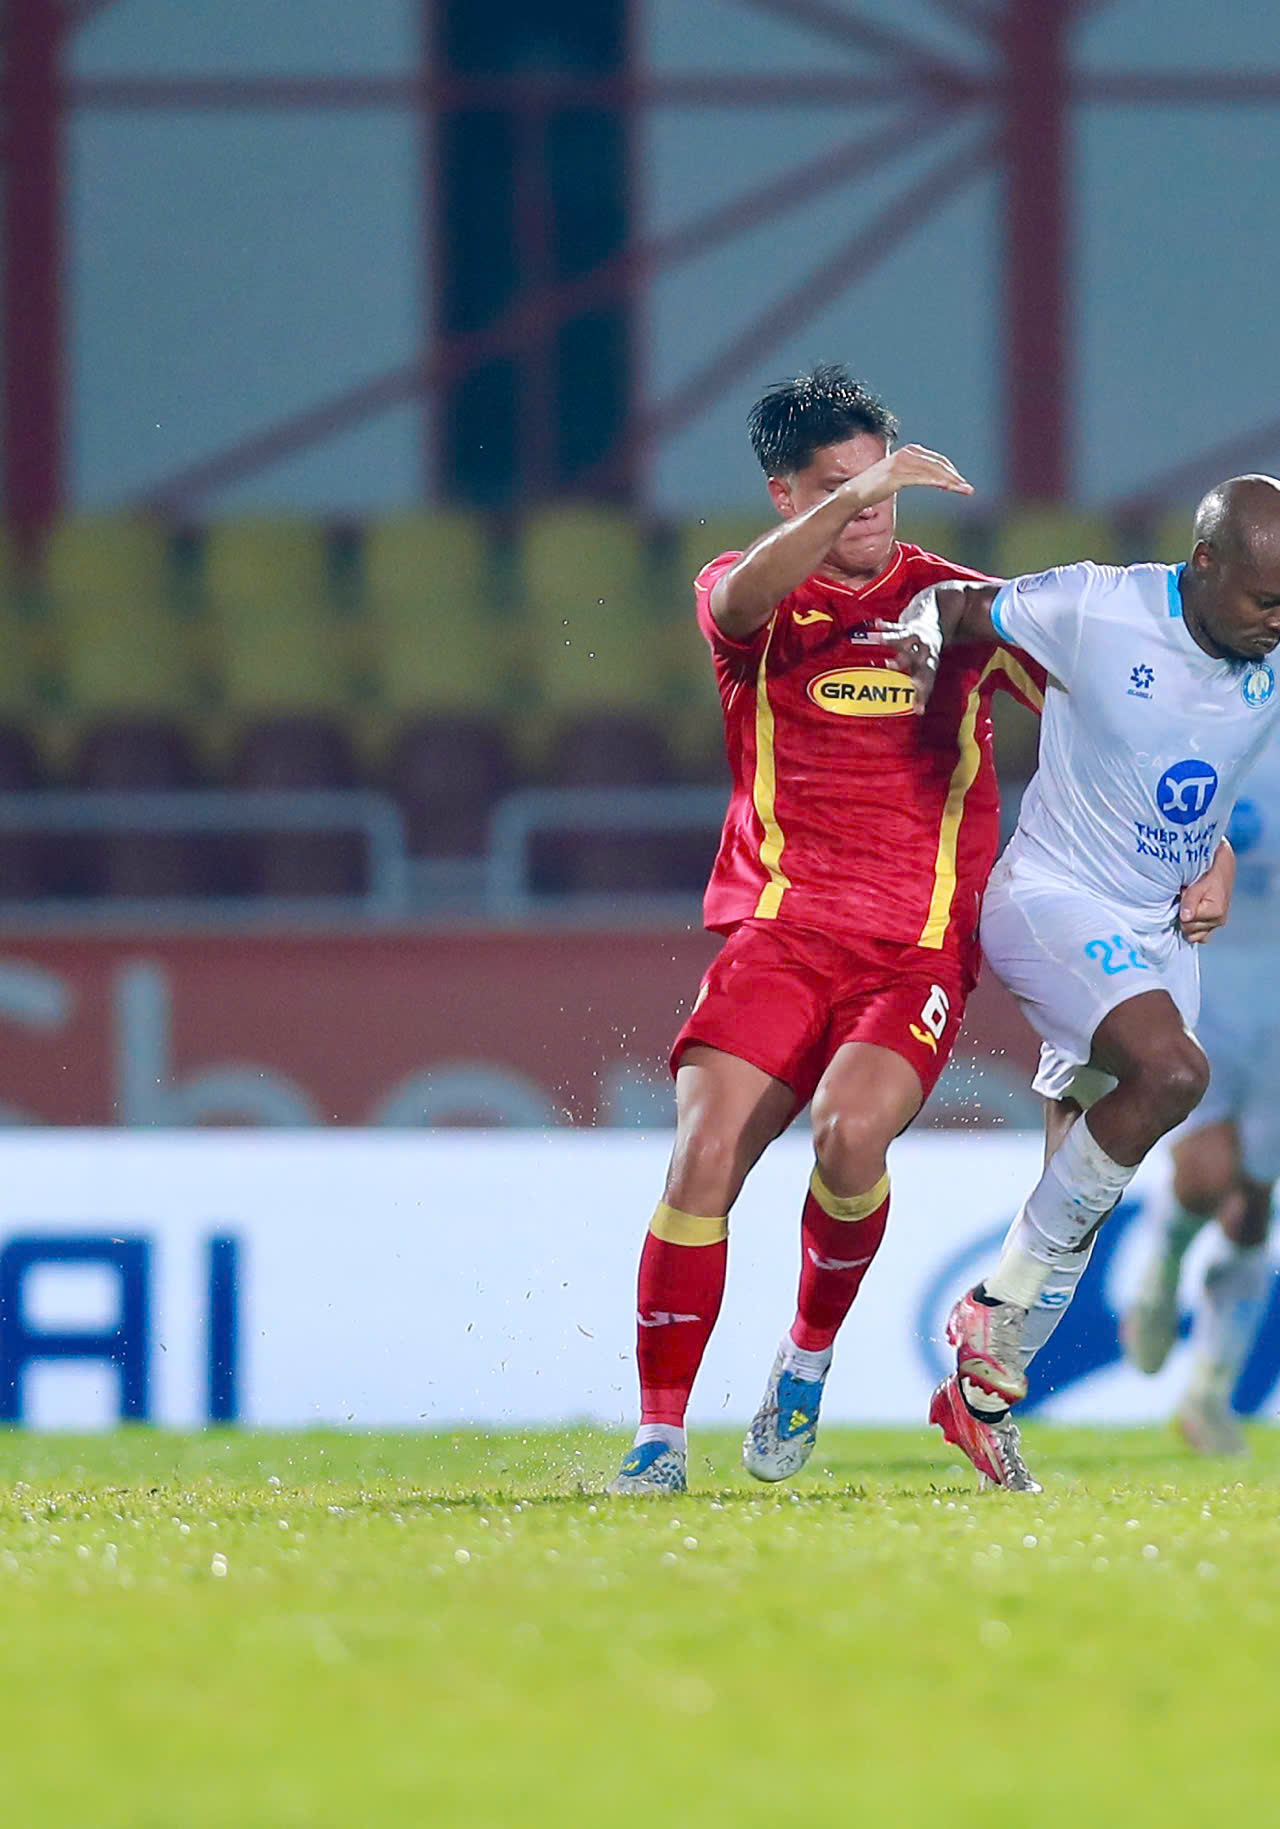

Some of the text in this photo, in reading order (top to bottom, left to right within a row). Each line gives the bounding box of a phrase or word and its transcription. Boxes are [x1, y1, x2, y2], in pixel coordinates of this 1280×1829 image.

[820, 682, 915, 704] GRANTT
[1084, 934, 1149, 976] 22
[920, 984, 950, 1040] 6
